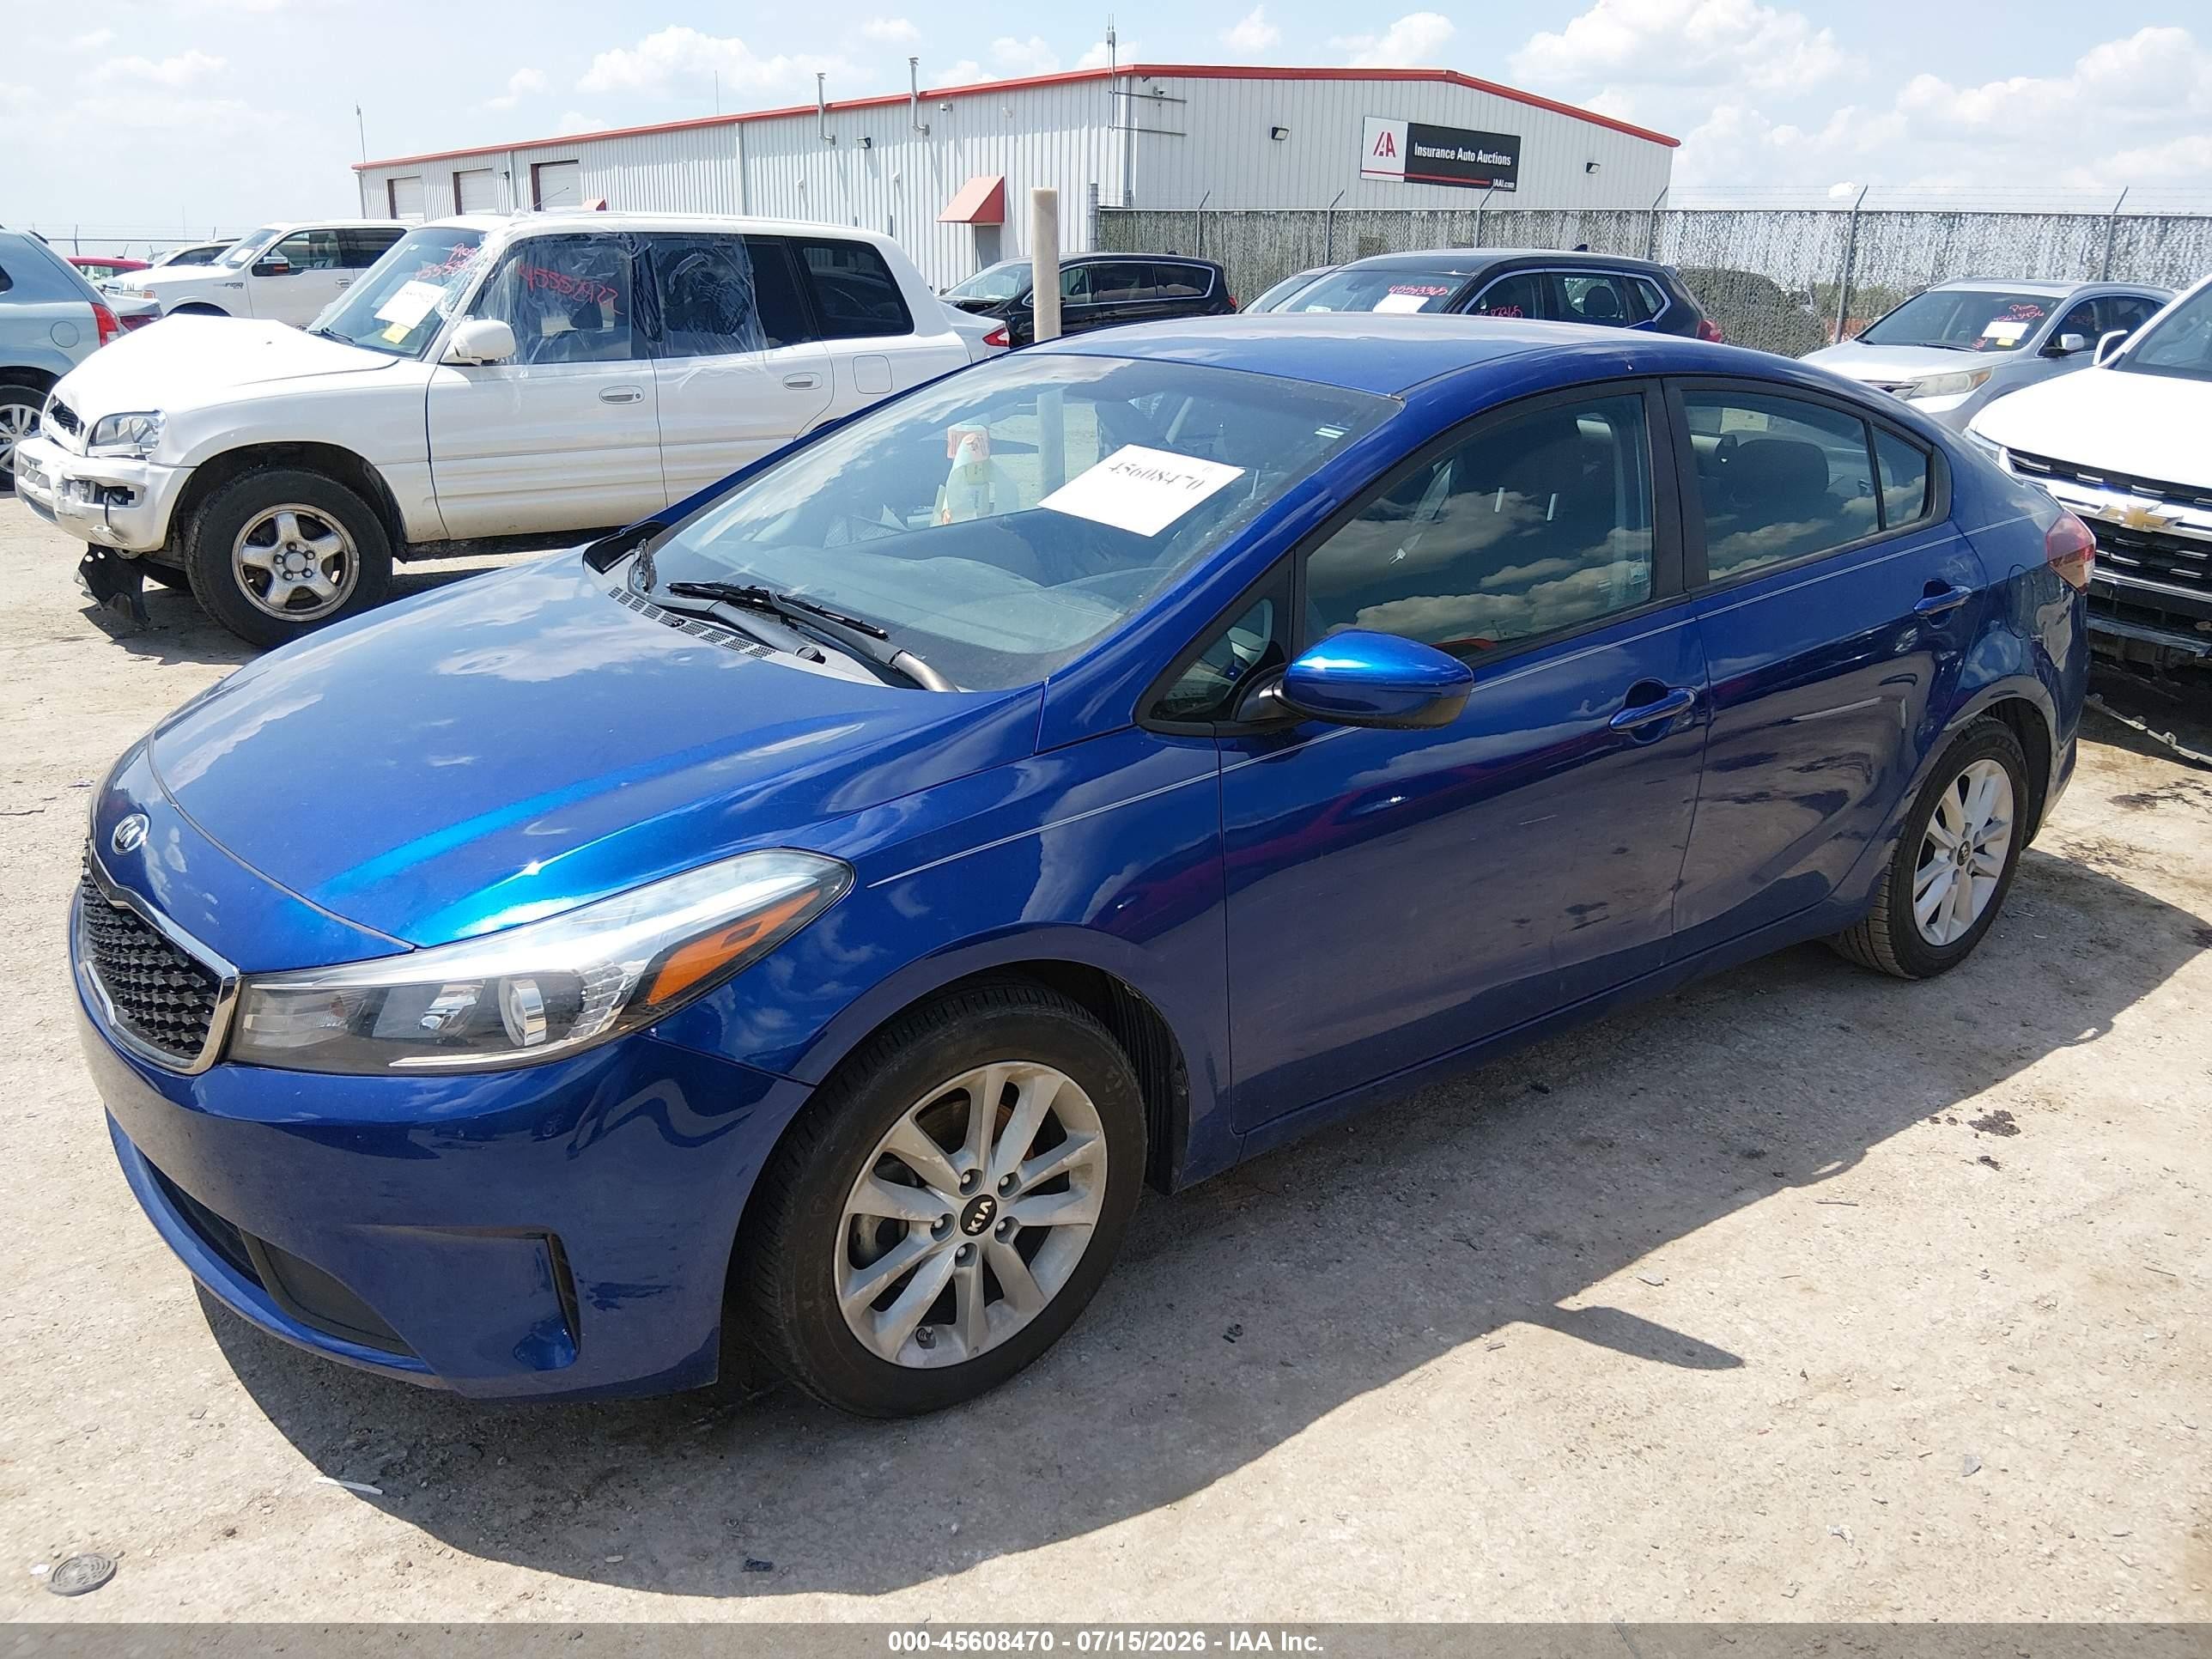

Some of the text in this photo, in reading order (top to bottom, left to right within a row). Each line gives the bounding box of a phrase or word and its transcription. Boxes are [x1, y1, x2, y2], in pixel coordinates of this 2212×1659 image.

[1414, 142, 1512, 166] Insurance Auto Auctions
[1109, 462, 1206, 490] 45608470
[967, 1200, 993, 1233] KIA
